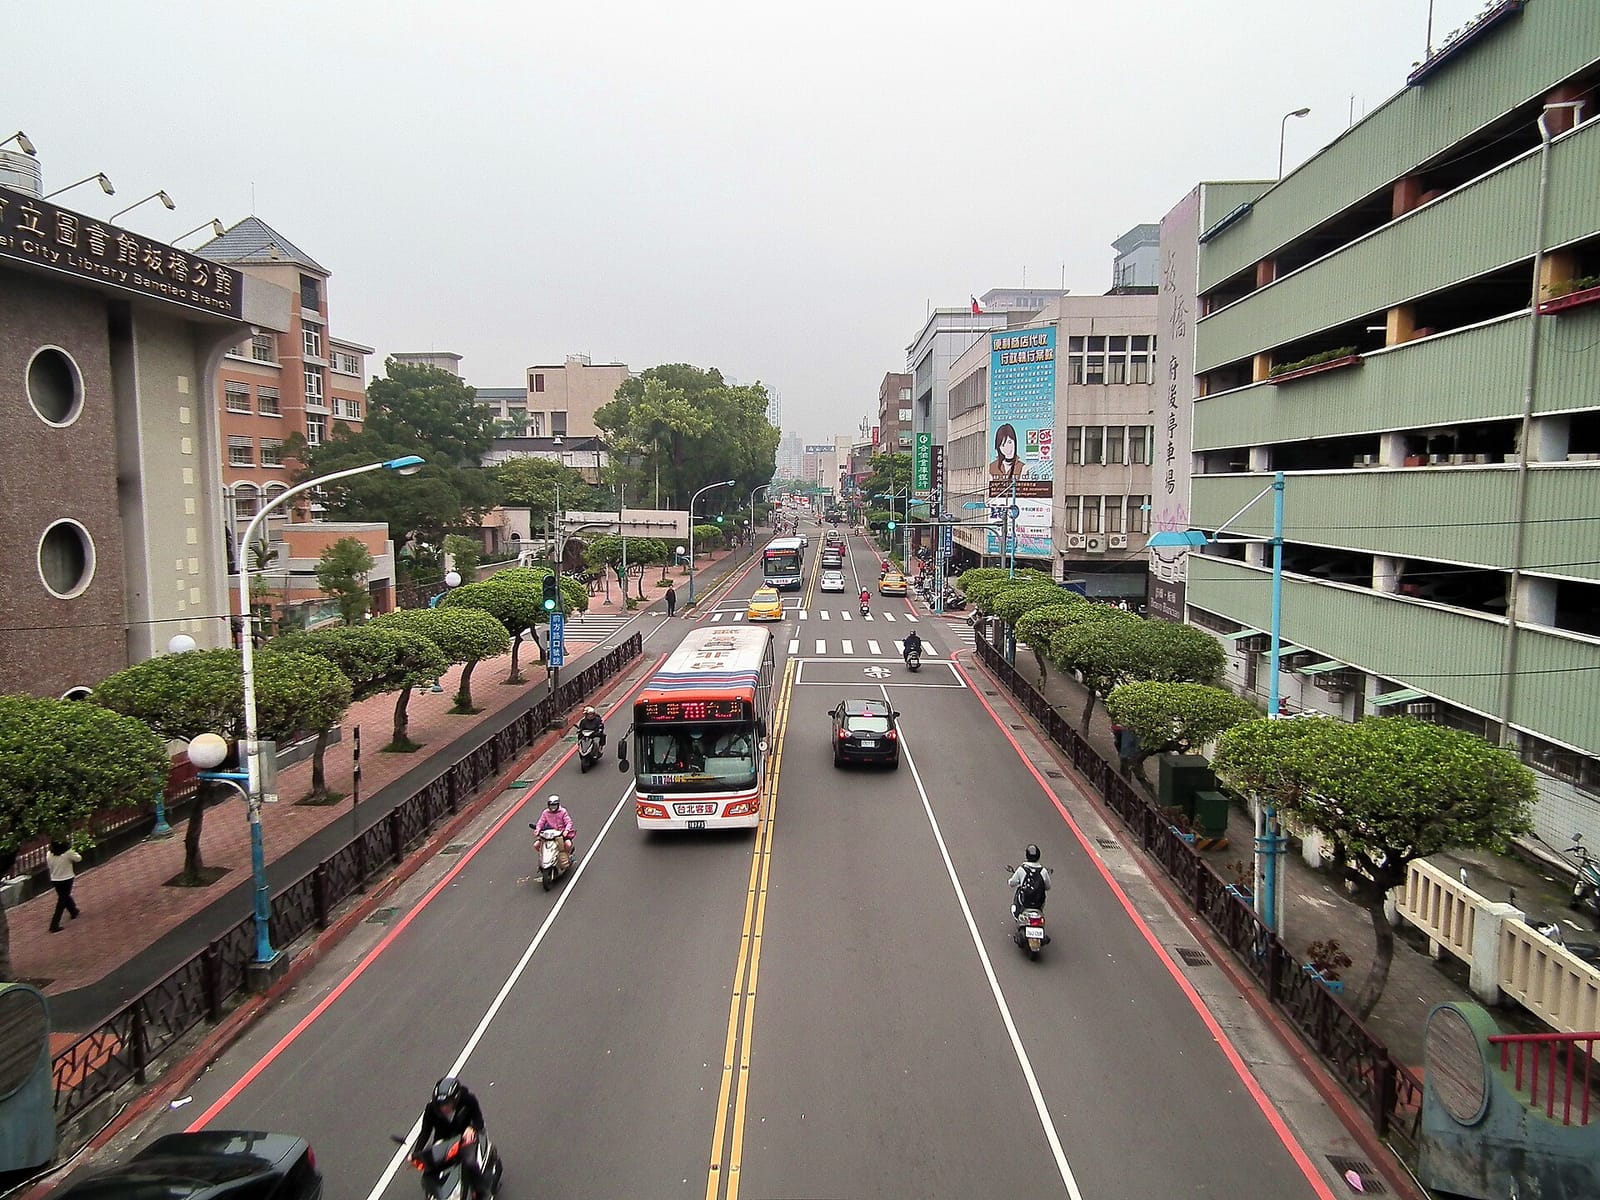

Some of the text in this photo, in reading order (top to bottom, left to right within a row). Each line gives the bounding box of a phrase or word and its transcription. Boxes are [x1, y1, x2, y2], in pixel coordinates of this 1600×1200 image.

[22, 240, 60, 263] City
[67, 253, 128, 282] Library
[133, 273, 187, 298] Banqiao
[191, 290, 232, 311] Branch
[552, 615, 561, 664] 前方路口號誌
[677, 804, 714, 814] 台北客運
